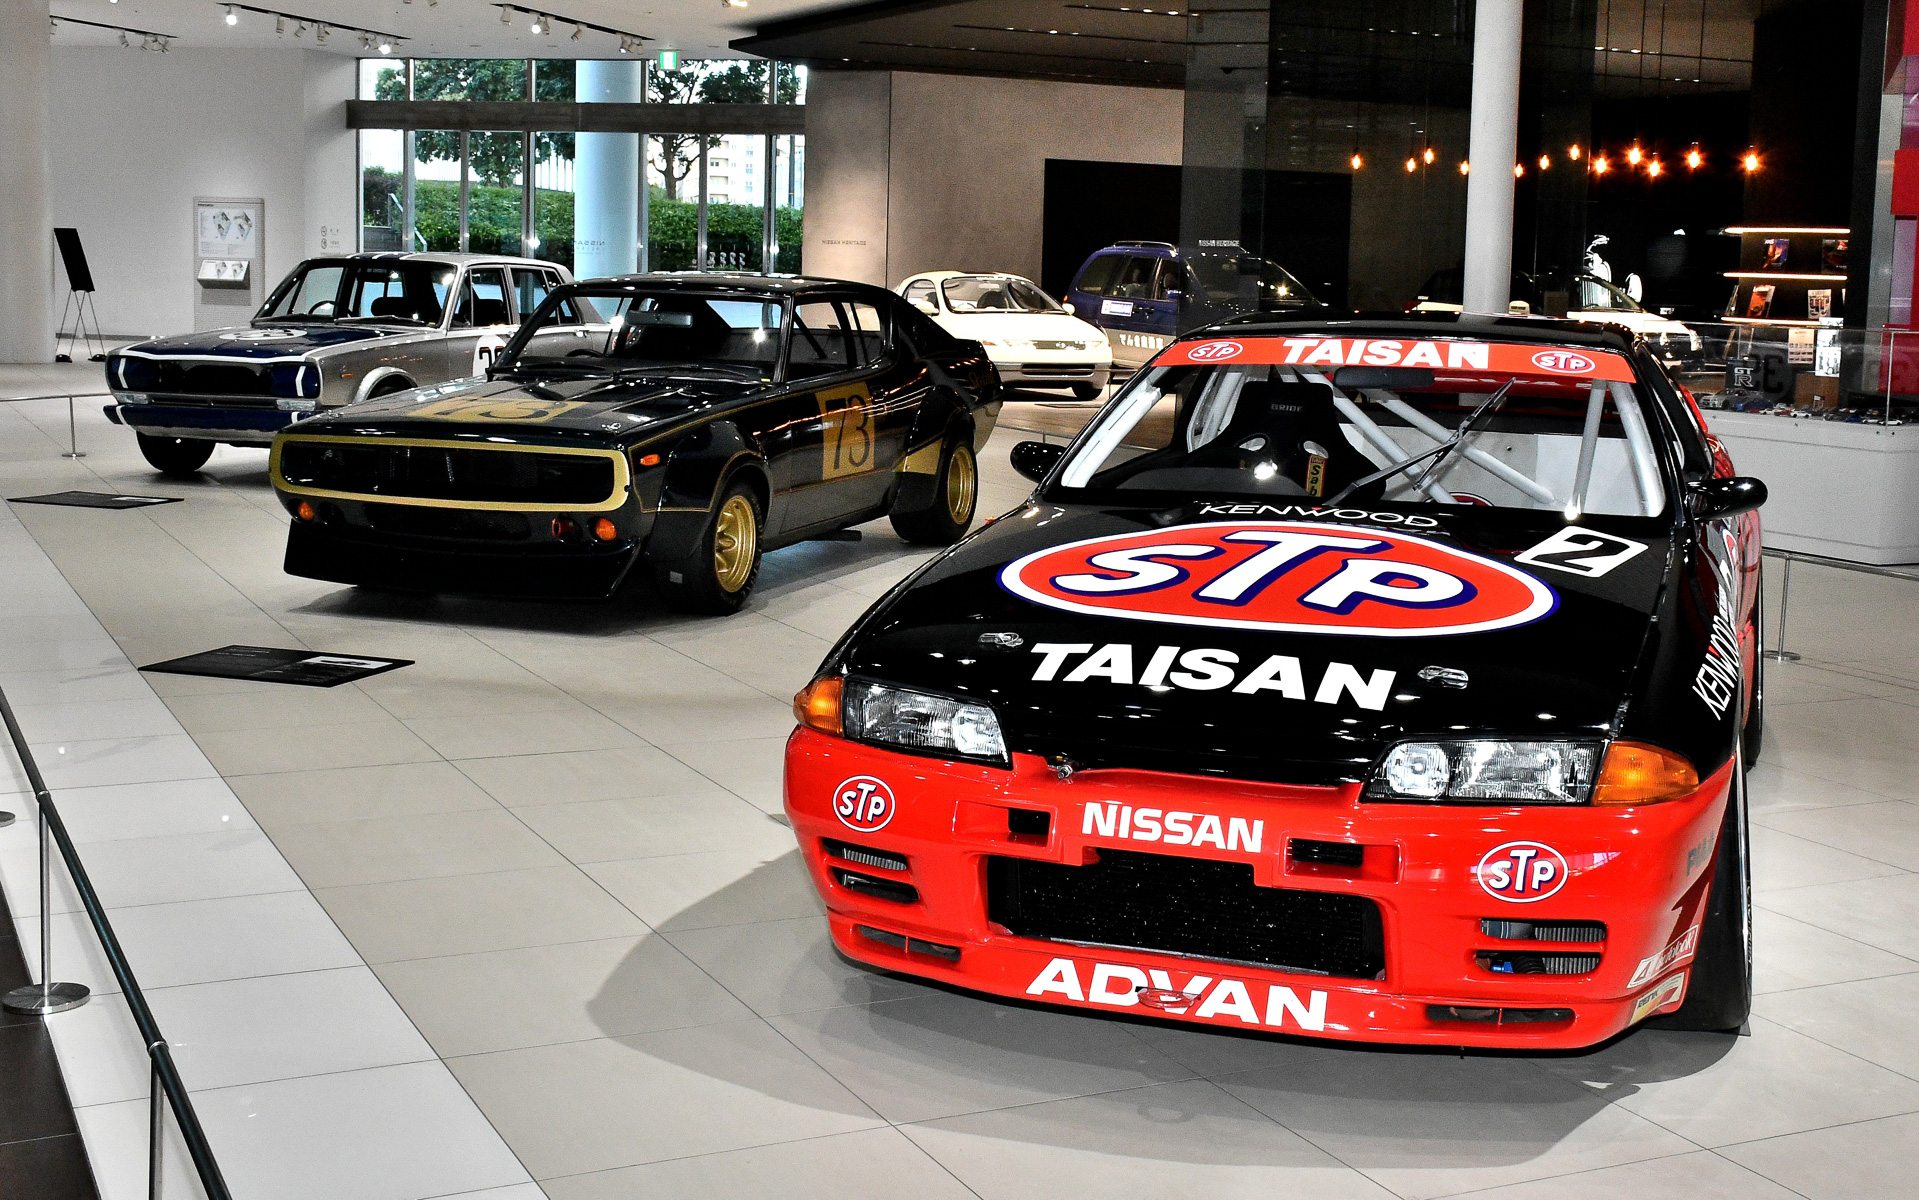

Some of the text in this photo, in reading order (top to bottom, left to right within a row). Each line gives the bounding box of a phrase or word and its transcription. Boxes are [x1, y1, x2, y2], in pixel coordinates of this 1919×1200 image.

[1195, 341, 1237, 357] STP
[1282, 338, 1490, 370] TAISAN
[1537, 351, 1588, 372] STP
[825, 393, 871, 470] 73
[1199, 503, 1439, 527] KENWOOD
[1050, 531, 1476, 616] STP
[1529, 533, 1631, 573] 2
[1030, 642, 1397, 712] TAISAN
[838, 781, 888, 824] STP
[1082, 801, 1265, 854] NISSAN
[1487, 848, 1558, 892] STP
[1025, 957, 1329, 1032] ADVAN
